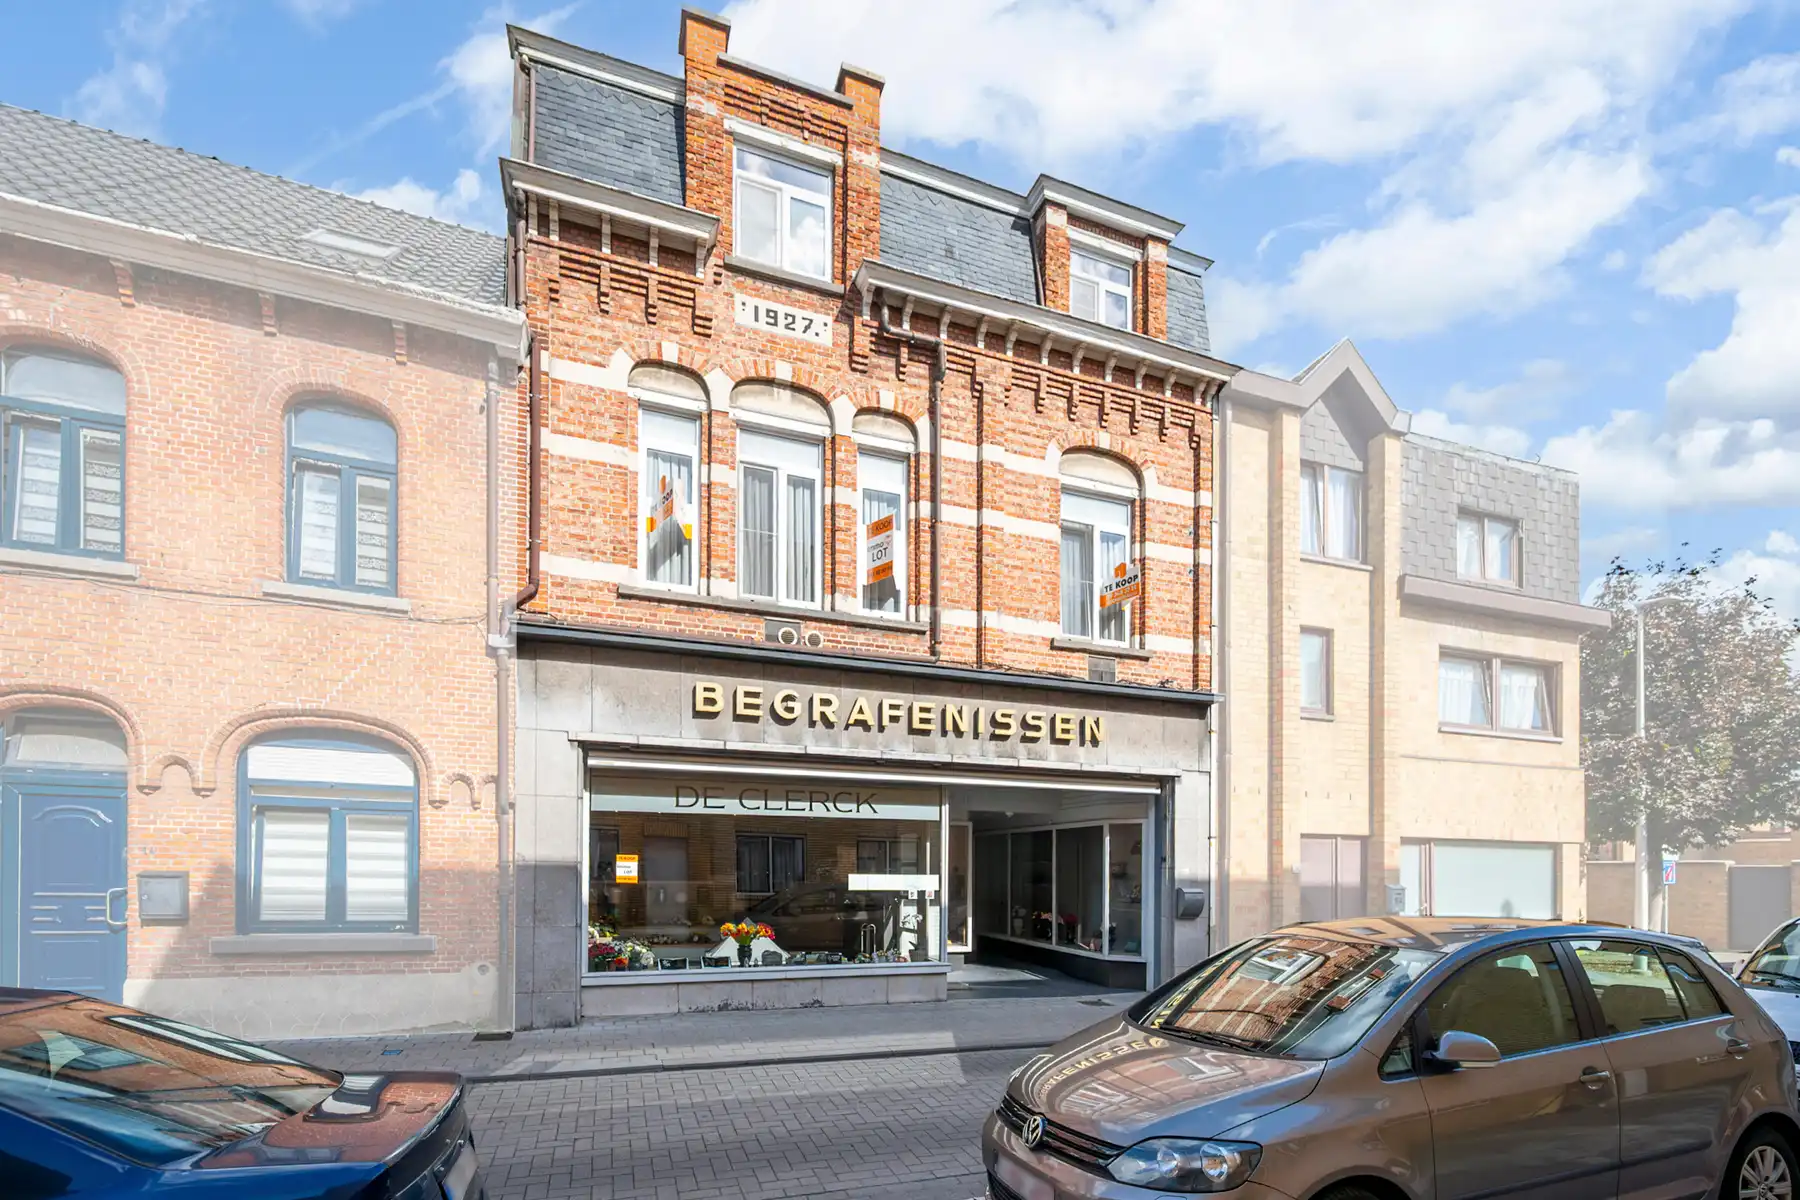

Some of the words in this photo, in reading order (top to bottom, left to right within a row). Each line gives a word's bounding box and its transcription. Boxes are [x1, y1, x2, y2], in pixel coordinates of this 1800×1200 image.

[871, 547, 888, 562] LOT
[1104, 584, 1113, 593] TE
[1115, 575, 1139, 589] KOOP
[693, 680, 1107, 744] BEGRAFENISSEN
[674, 786, 725, 809] DE
[739, 788, 878, 815] CLERCK
